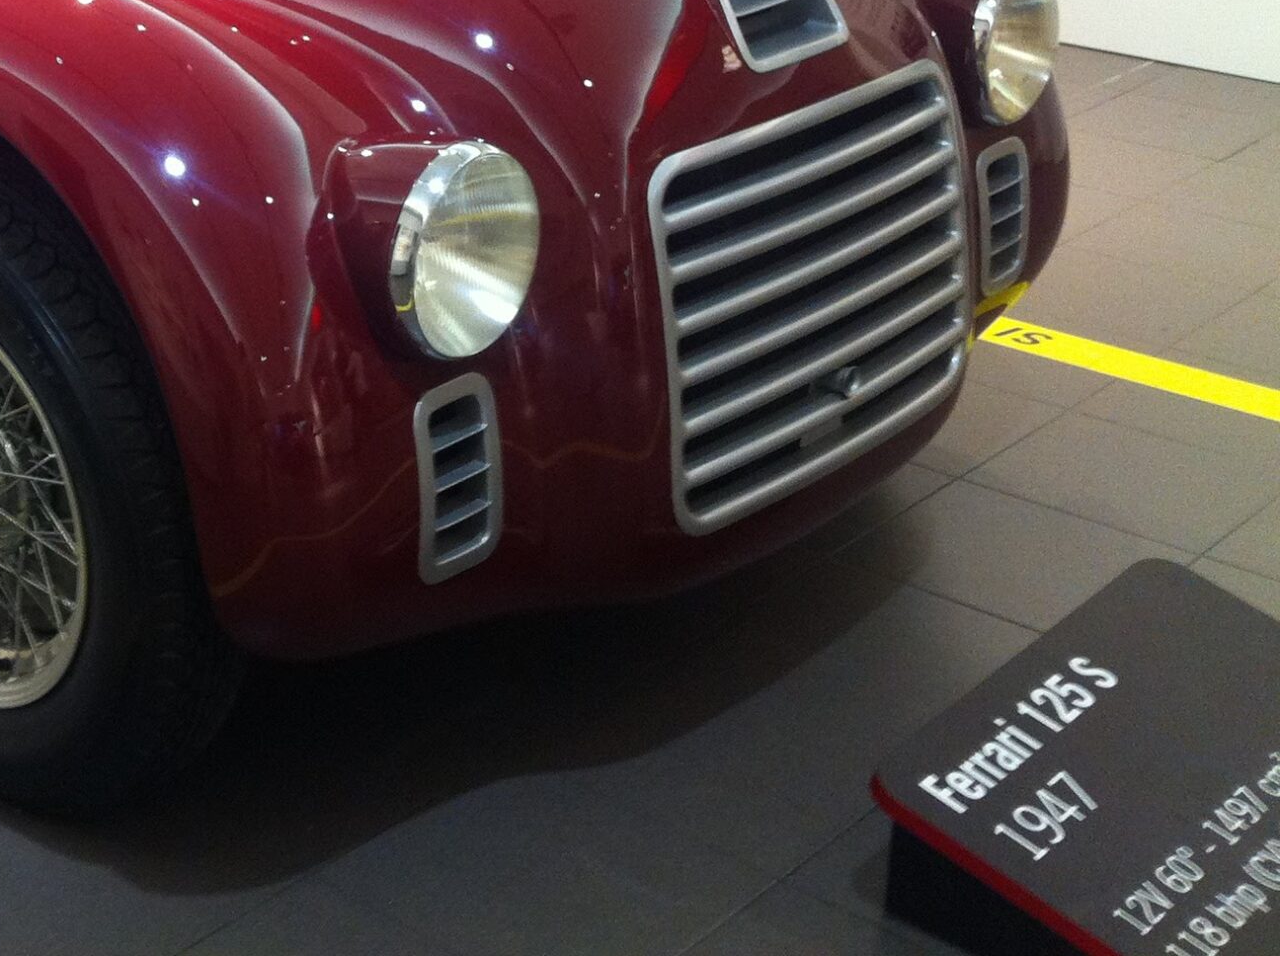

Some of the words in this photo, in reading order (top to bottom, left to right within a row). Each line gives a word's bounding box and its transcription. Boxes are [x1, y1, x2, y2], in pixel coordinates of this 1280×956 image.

[917, 717, 1045, 815] Ferrari
[1017, 673, 1097, 733] 125
[1067, 656, 1120, 689] S
[994, 770, 1099, 862] 1947
[1112, 880, 1175, 937] 12V
[1155, 845, 1206, 894] 60°
[1201, 785, 1270, 846] 1497
[1204, 882, 1272, 930] bhp
